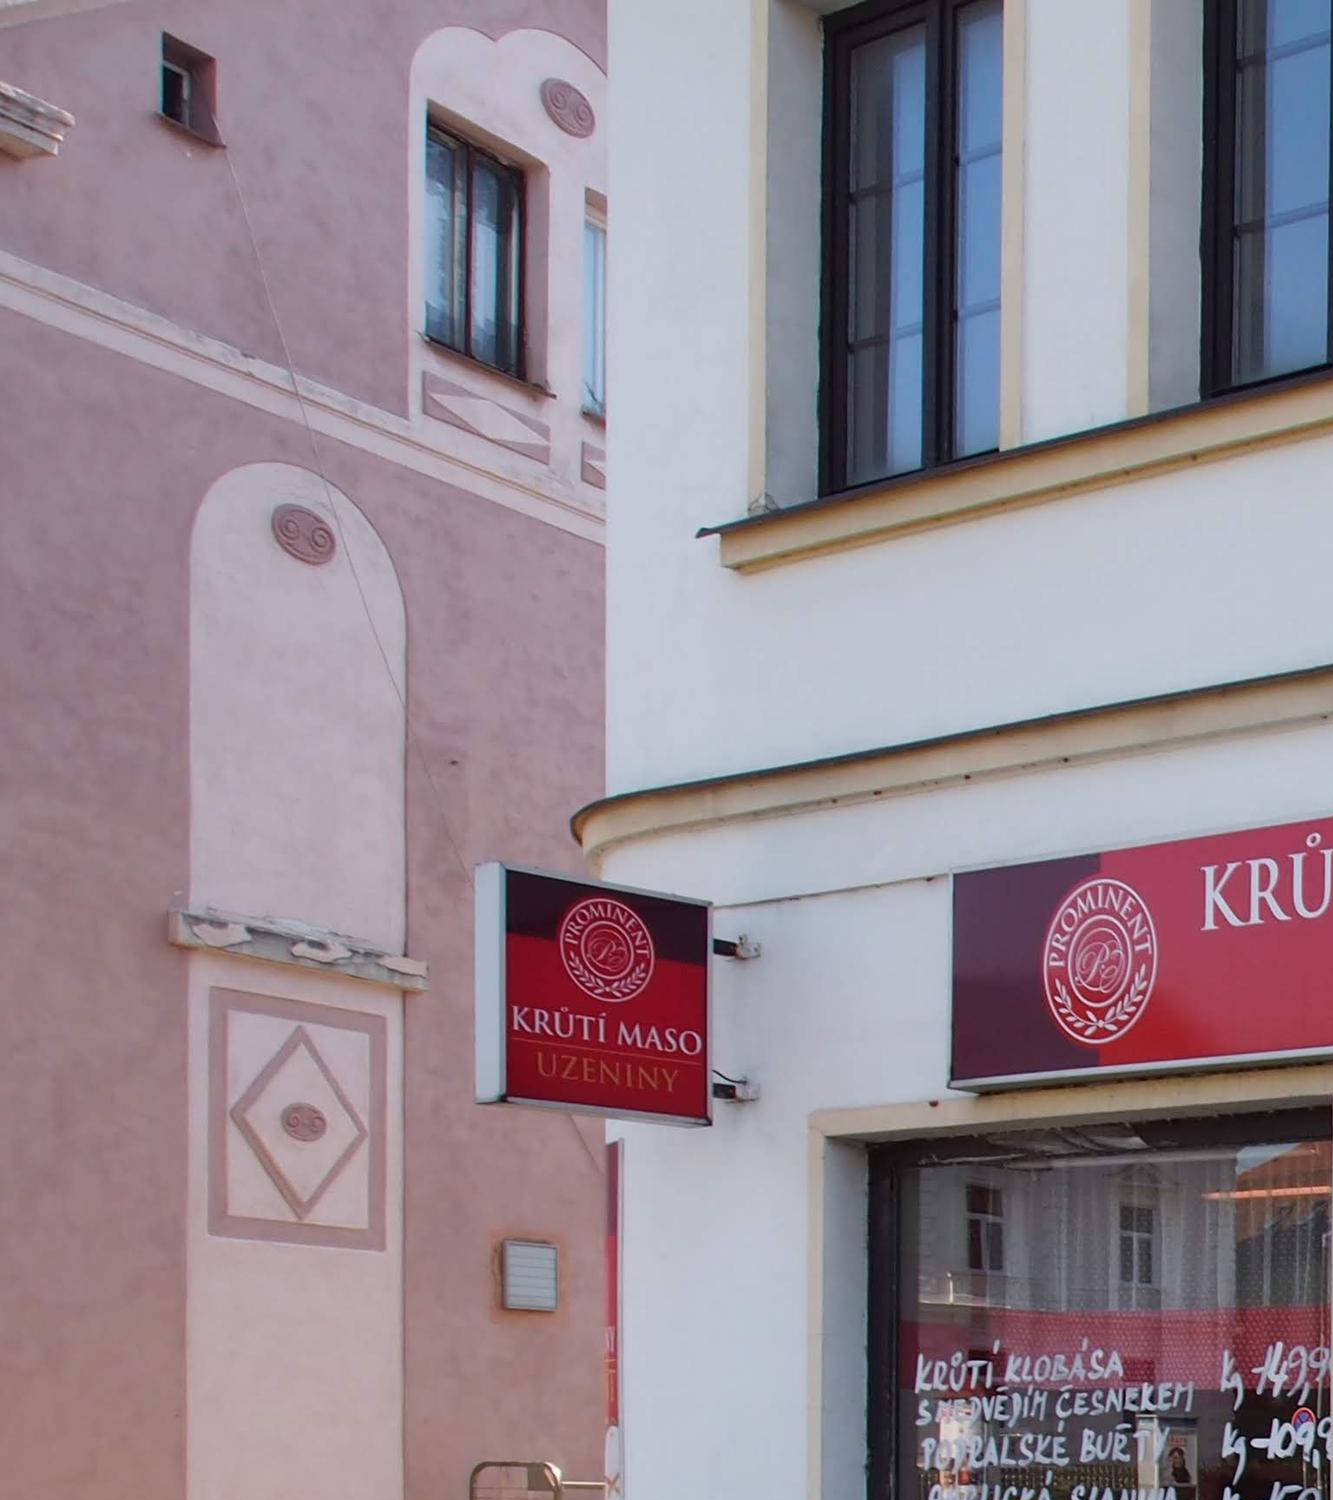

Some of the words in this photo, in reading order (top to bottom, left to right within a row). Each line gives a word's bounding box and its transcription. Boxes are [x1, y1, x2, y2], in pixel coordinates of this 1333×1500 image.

[565, 902, 649, 958] PROMINENT
[1049, 885, 1152, 966] PROMINENT
[511, 1006, 607, 1043] KRŮTÍ
[618, 1022, 702, 1055] MASO
[537, 1052, 679, 1093] UZENINY
[915, 1399, 933, 1426] S
